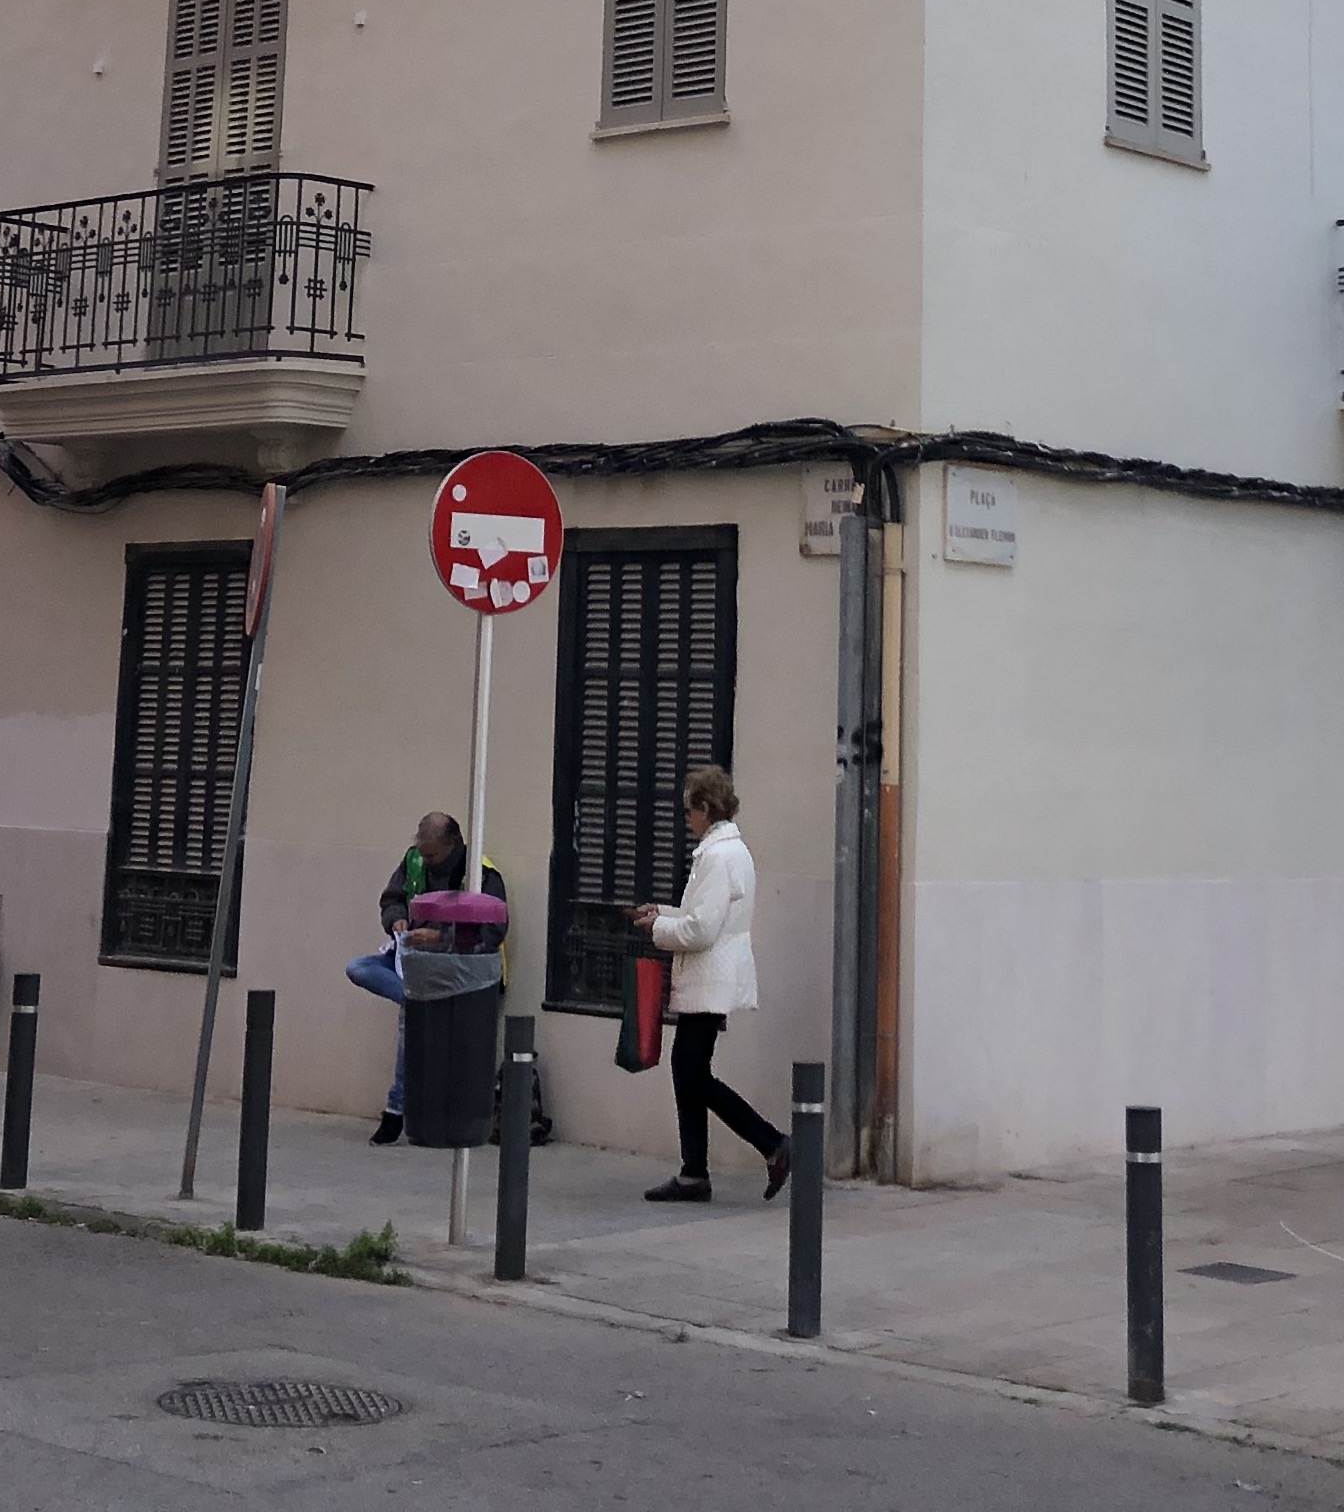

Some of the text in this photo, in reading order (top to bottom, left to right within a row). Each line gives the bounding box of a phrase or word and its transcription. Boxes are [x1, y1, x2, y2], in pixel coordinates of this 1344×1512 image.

[824, 479, 855, 493] CARR
[969, 490, 996, 510] PLAÇA
[805, 521, 834, 537] MARIA
